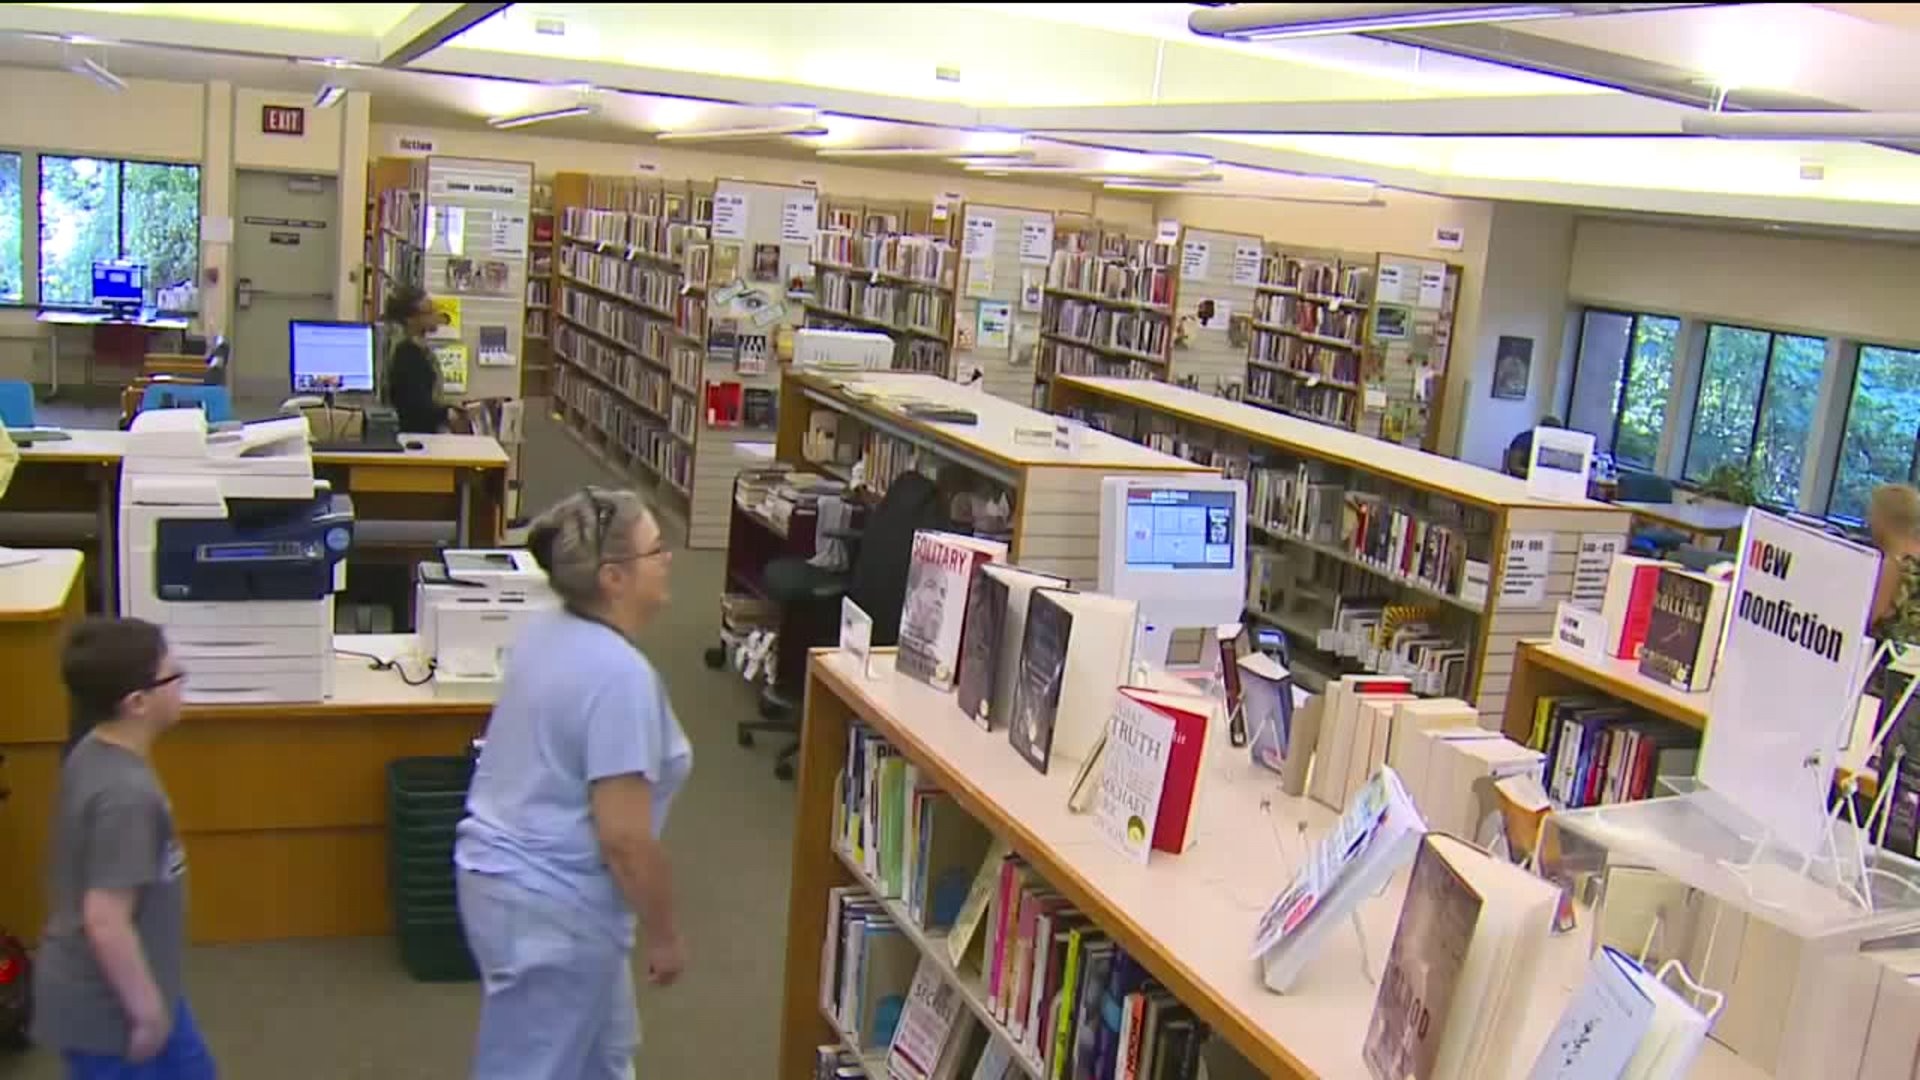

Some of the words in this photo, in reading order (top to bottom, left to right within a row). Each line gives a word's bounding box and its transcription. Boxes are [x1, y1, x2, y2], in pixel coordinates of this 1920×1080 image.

[269, 109, 299, 131] EXIT
[913, 534, 968, 576] SOLITARY
[1749, 539, 1793, 581] new
[1738, 588, 1843, 663] nonfiction
[1110, 718, 1162, 761] TRUTH
